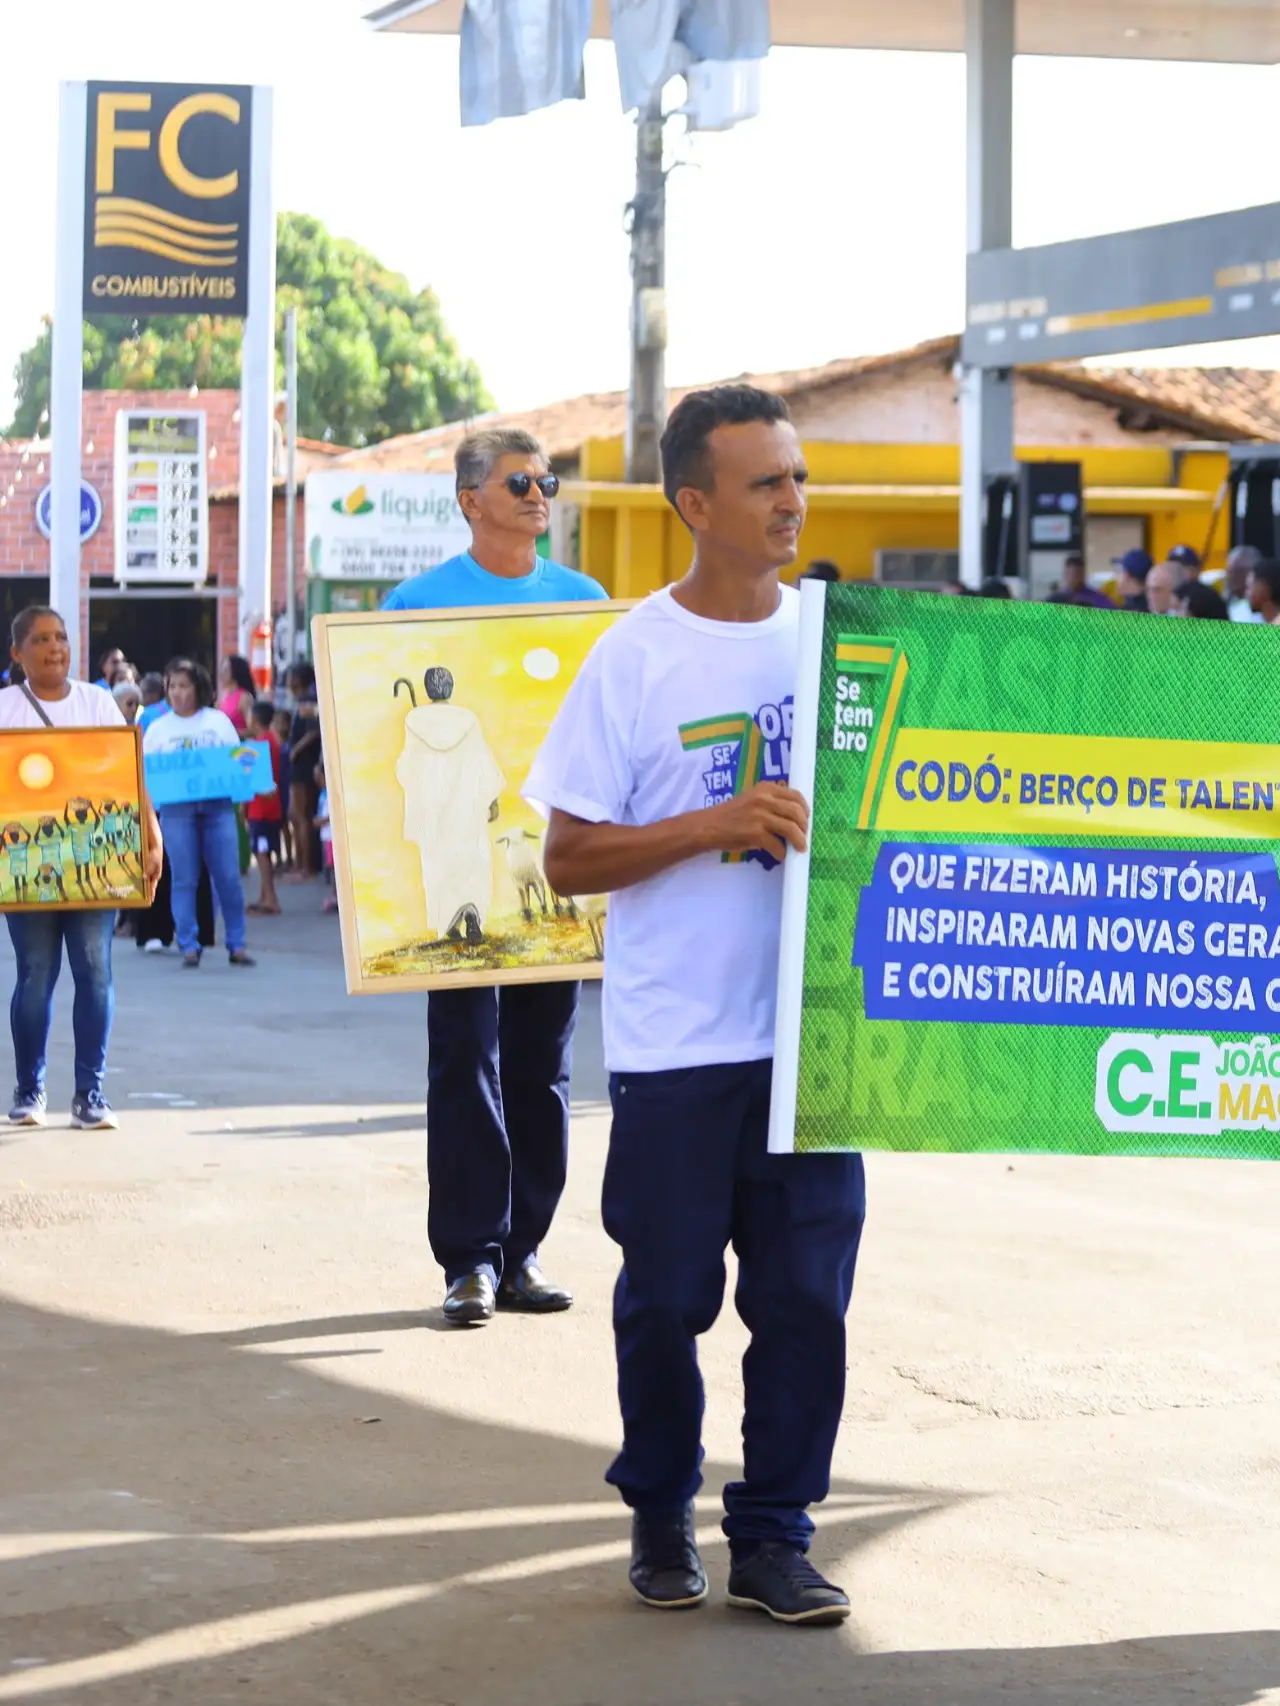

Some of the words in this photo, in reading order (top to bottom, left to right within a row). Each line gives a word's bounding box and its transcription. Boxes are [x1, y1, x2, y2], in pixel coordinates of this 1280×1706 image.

[96, 92, 240, 198] FC
[92, 271, 236, 298] COMBUSTÍVEIS
[835, 676, 861, 701] Se
[834, 701, 873, 727] tem
[712, 745, 732, 766] SE
[833, 725, 868, 751] bro
[704, 770, 732, 791] TEM
[895, 753, 1012, 804] CODÓ:
[1019, 773, 1119, 814] BERÇO
[1128, 777, 1167, 809] DE
[889, 852, 956, 894] QUE
[963, 855, 1098, 897] FIZERAM
[1106, 860, 1268, 912] HISTÓRIA,
[885, 906, 1078, 950] INSPIRARAM
[1086, 915, 1196, 956] NOVAS
[882, 961, 902, 998] E
[908, 961, 1136, 1007] CONSTRUÍRAM
[1145, 973, 1256, 1012] NOSSA
[1106, 1048, 1212, 1119] C.E.
